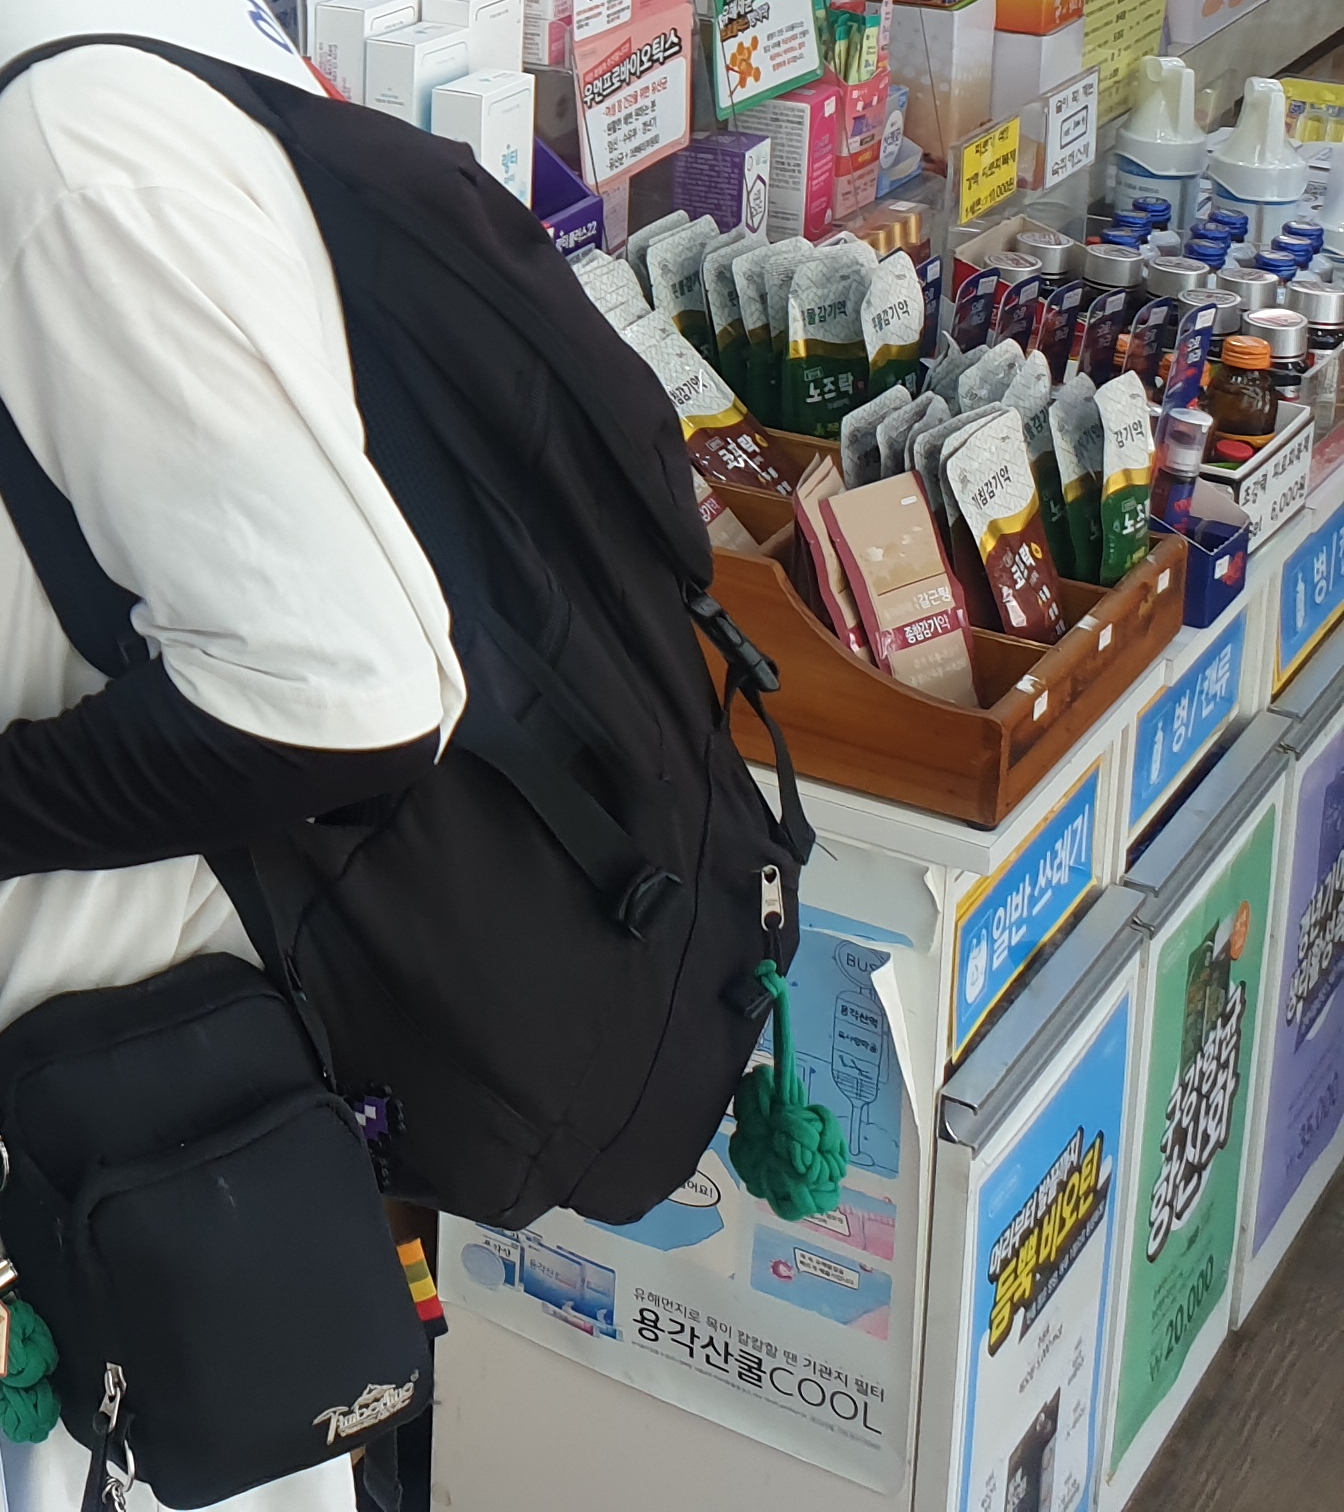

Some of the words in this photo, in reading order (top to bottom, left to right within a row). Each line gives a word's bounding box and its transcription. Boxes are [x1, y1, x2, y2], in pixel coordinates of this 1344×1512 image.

[904, 613, 951, 644] 종합감기약
[991, 880, 1032, 966] 일반
[1034, 811, 1090, 915] 쓰레기
[845, 952, 879, 975] BUS
[632, 1306, 883, 1436] 용각산쿨COOL
[633, 1287, 702, 1324] 유해먼지로
[705, 1314, 733, 1339] 목이
[802, 1357, 849, 1388] 기관지
[854, 1377, 886, 1403] 필터
